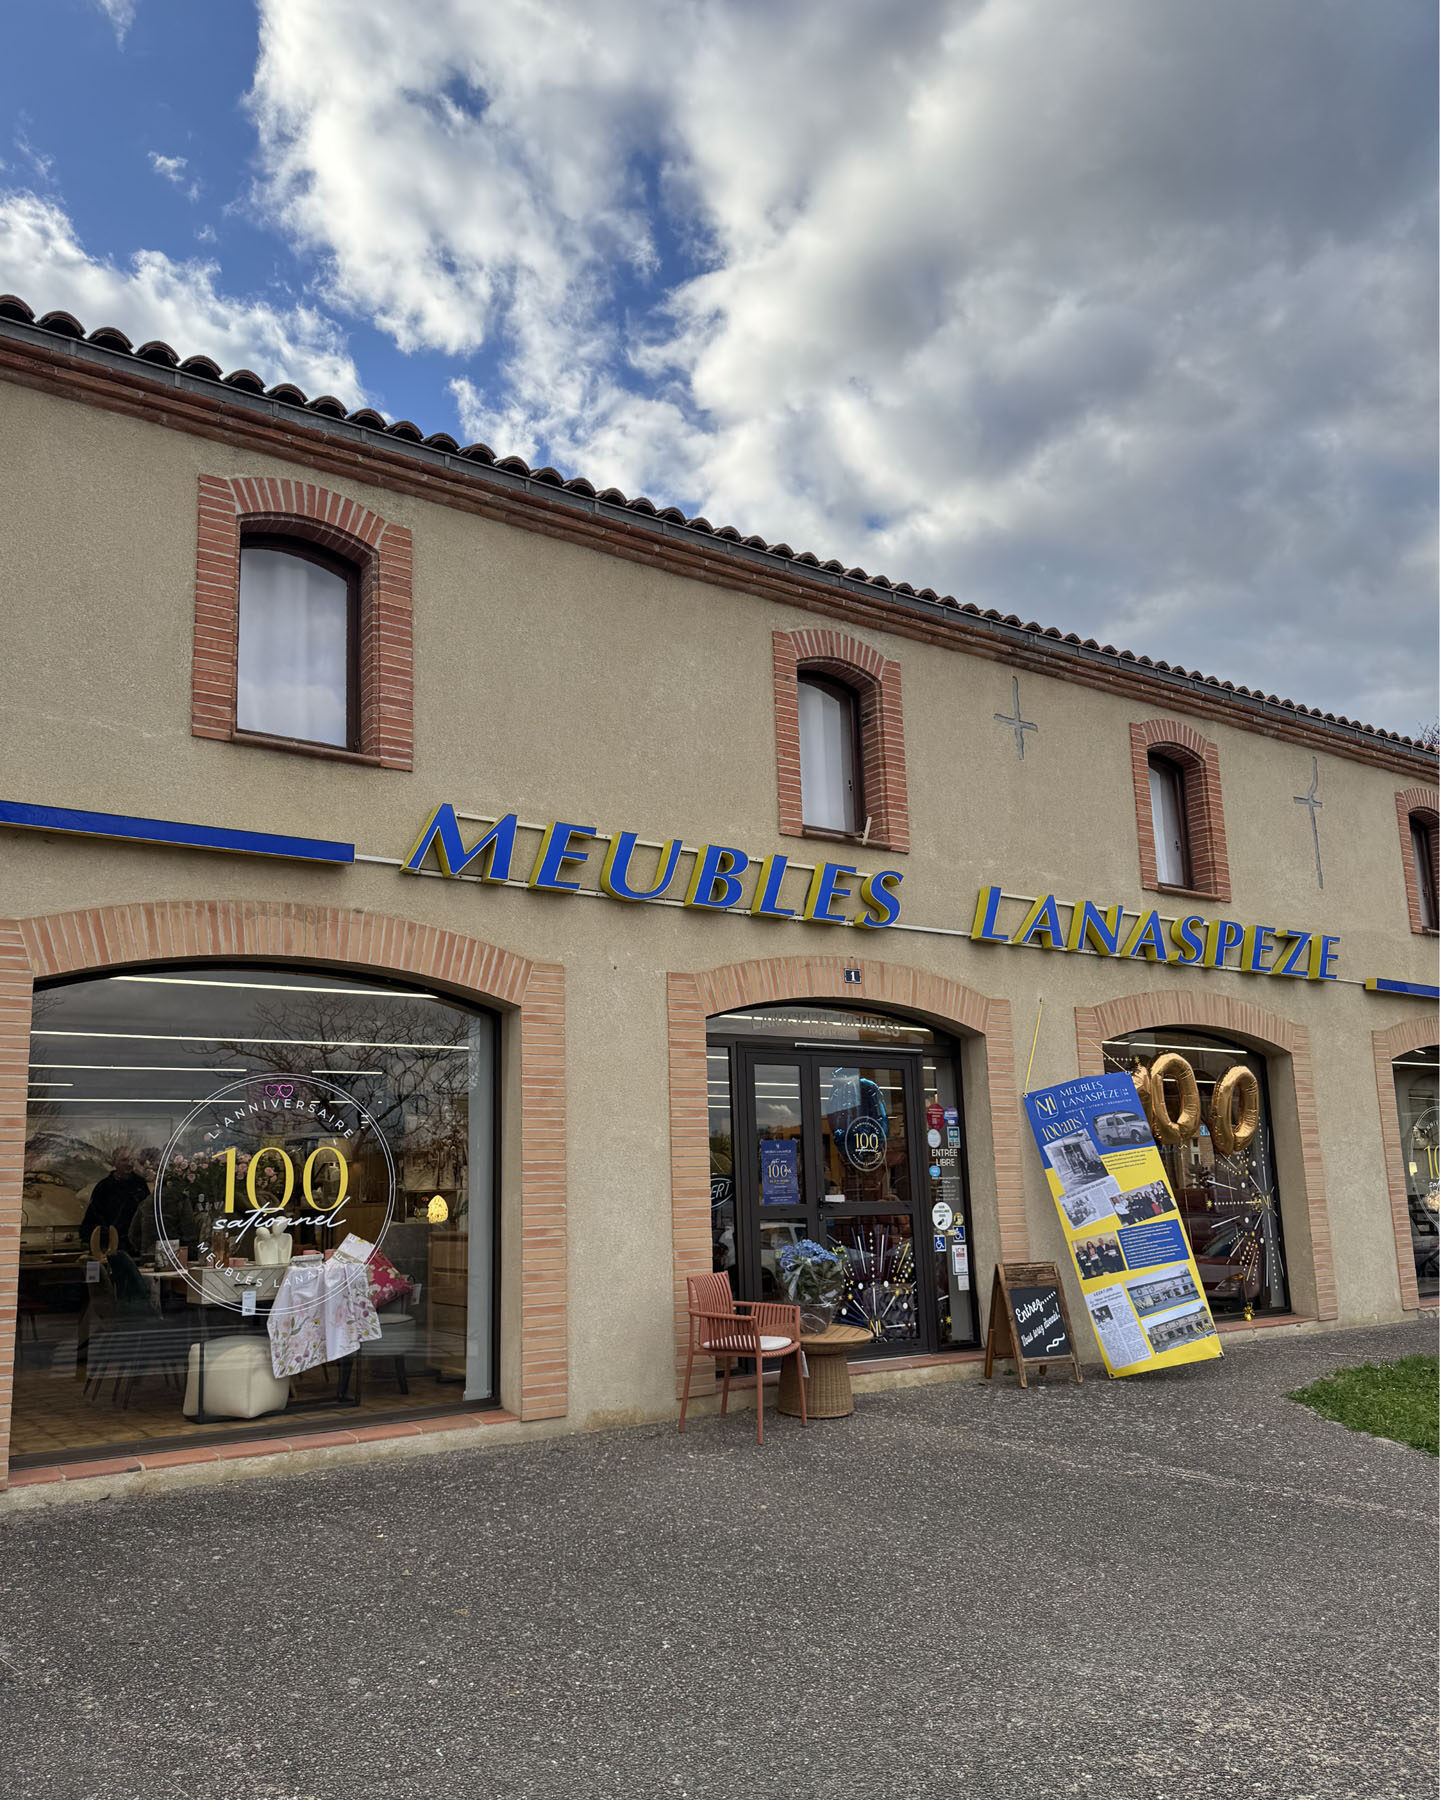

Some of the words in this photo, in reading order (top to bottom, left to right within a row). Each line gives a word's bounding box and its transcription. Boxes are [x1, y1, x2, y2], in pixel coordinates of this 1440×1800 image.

[400, 802, 904, 931] MEUBLES
[971, 885, 1342, 981] LANASPEZE
[1060, 1081, 1104, 1098] MEUBLES
[207, 1098, 354, 1140] L'ANNIVERSAIRE
[853, 1132, 879, 1149] 100
[931, 1148, 958, 1157] ENTRÉE
[767, 1164, 787, 1178] 100
[936, 1158, 955, 1167] LIBRE
[212, 1146, 349, 1214] 100
[212, 1197, 350, 1244] sationnel
[197, 1241, 263, 1288] MEUBLES
